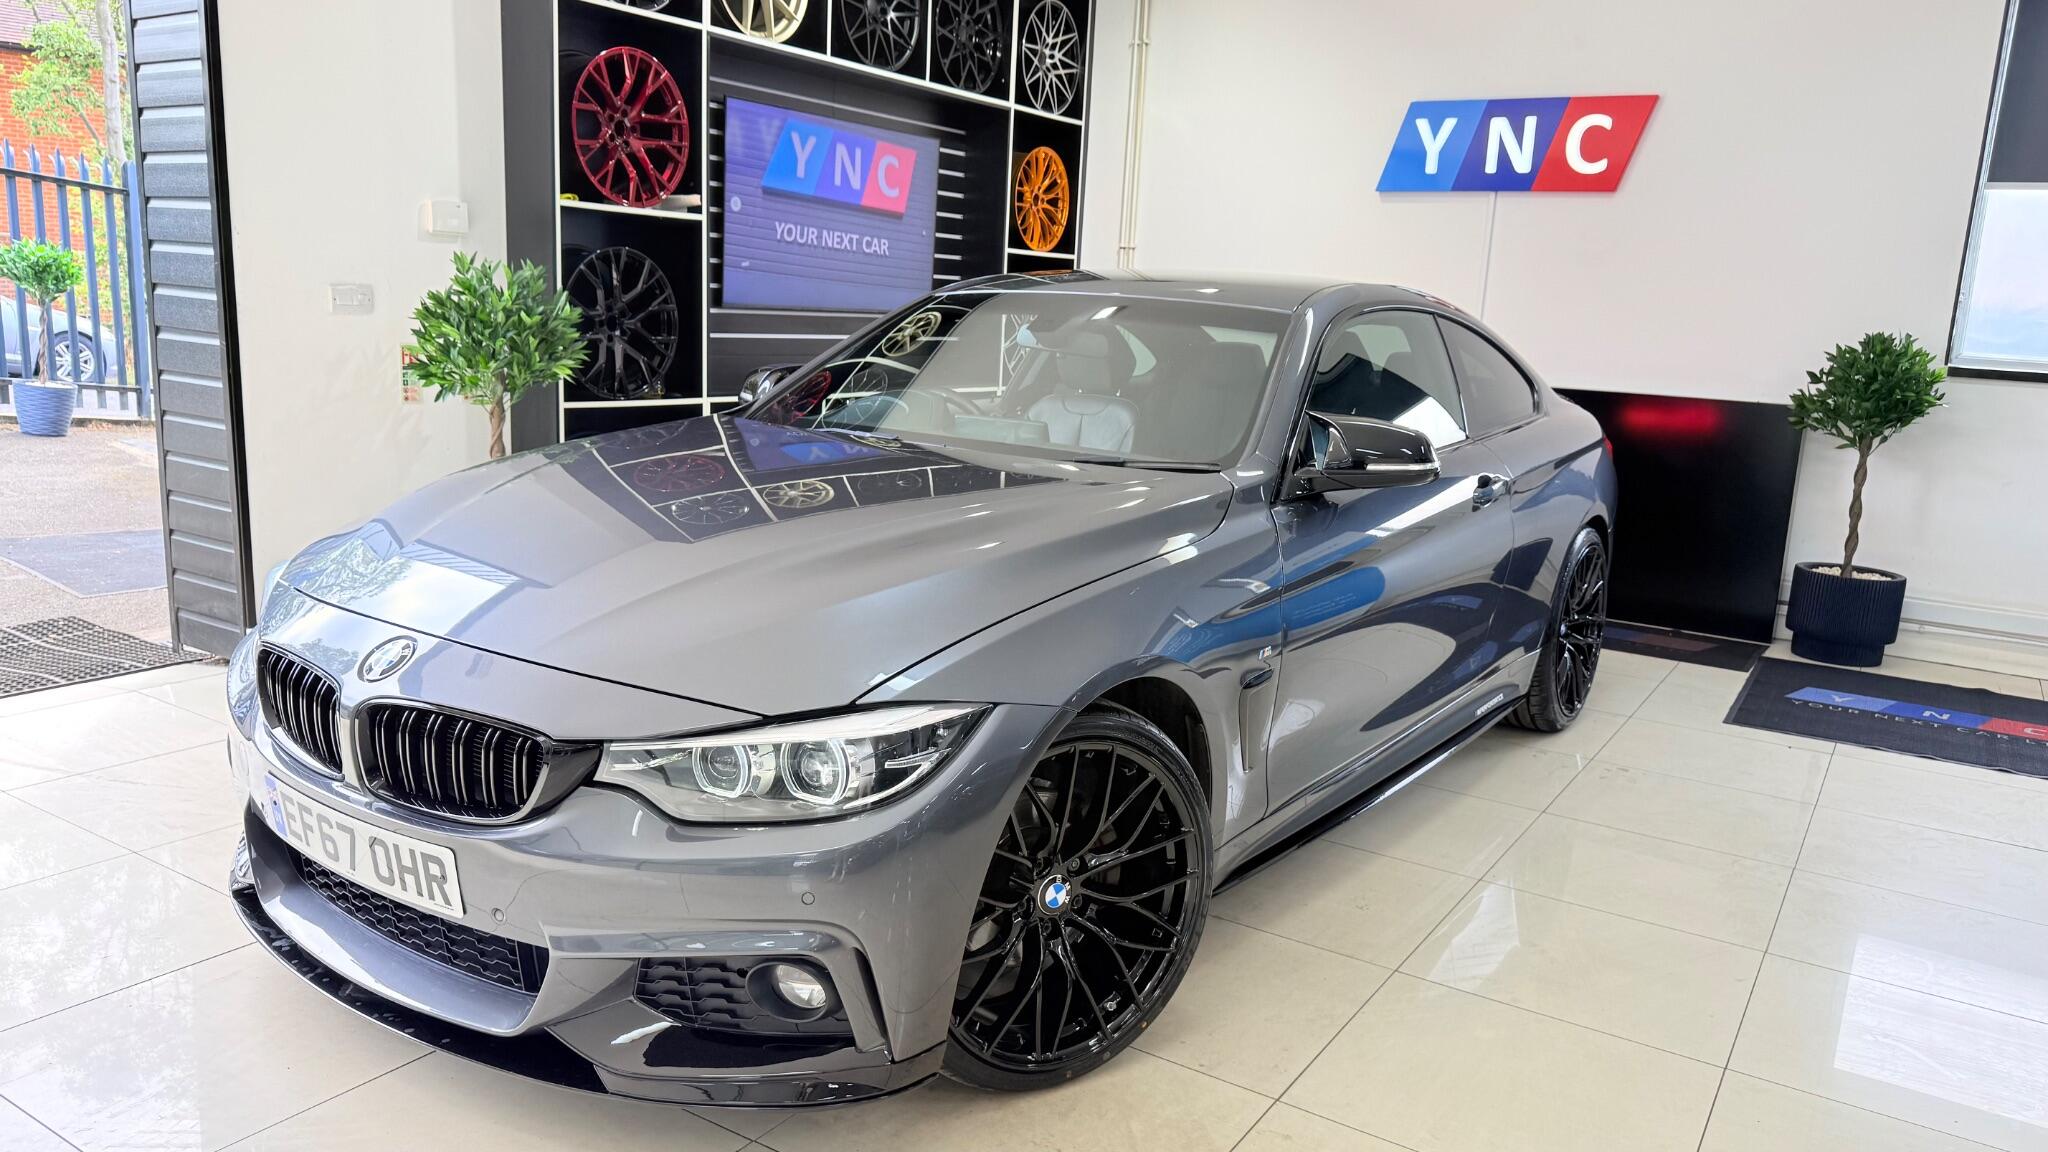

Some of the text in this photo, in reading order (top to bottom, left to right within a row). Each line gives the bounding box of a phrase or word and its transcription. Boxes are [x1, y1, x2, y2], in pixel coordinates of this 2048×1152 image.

[791, 131, 900, 198] YNC
[1415, 113, 1613, 175] YNC
[775, 221, 889, 256] YOUR NEXT CAR
[1791, 700, 1859, 714] YOUR
[1874, 713, 1941, 728] NEXT
[1956, 727, 2009, 740] CAR
[280, 791, 453, 907] EF67 OHR
